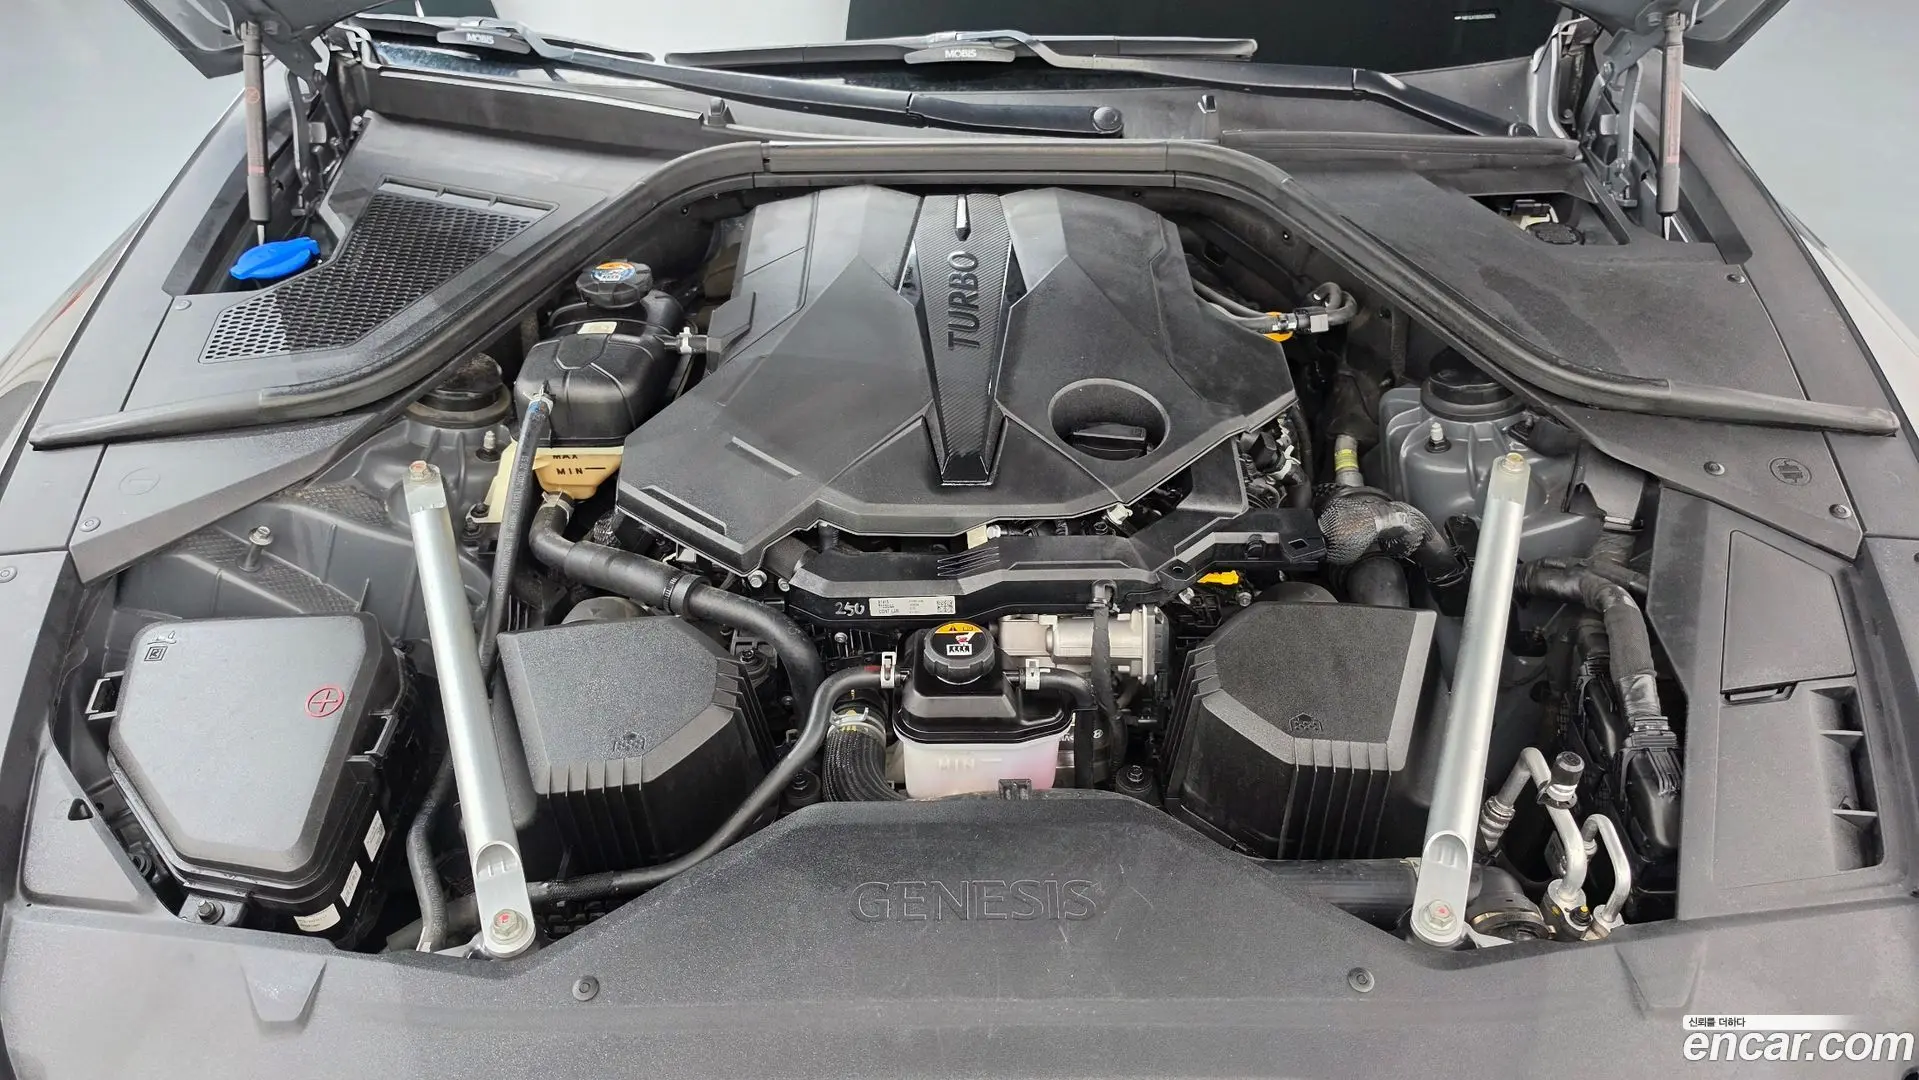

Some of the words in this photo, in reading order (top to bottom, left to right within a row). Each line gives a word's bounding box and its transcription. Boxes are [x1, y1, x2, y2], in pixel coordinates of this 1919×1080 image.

[466, 32, 495, 45] MOBIS
[944, 49, 977, 59] MOBIS
[947, 250, 980, 350] TURBO
[556, 467, 584, 475] MIN
[834, 601, 866, 617] 250
[850, 879, 1097, 922] GENESIS
